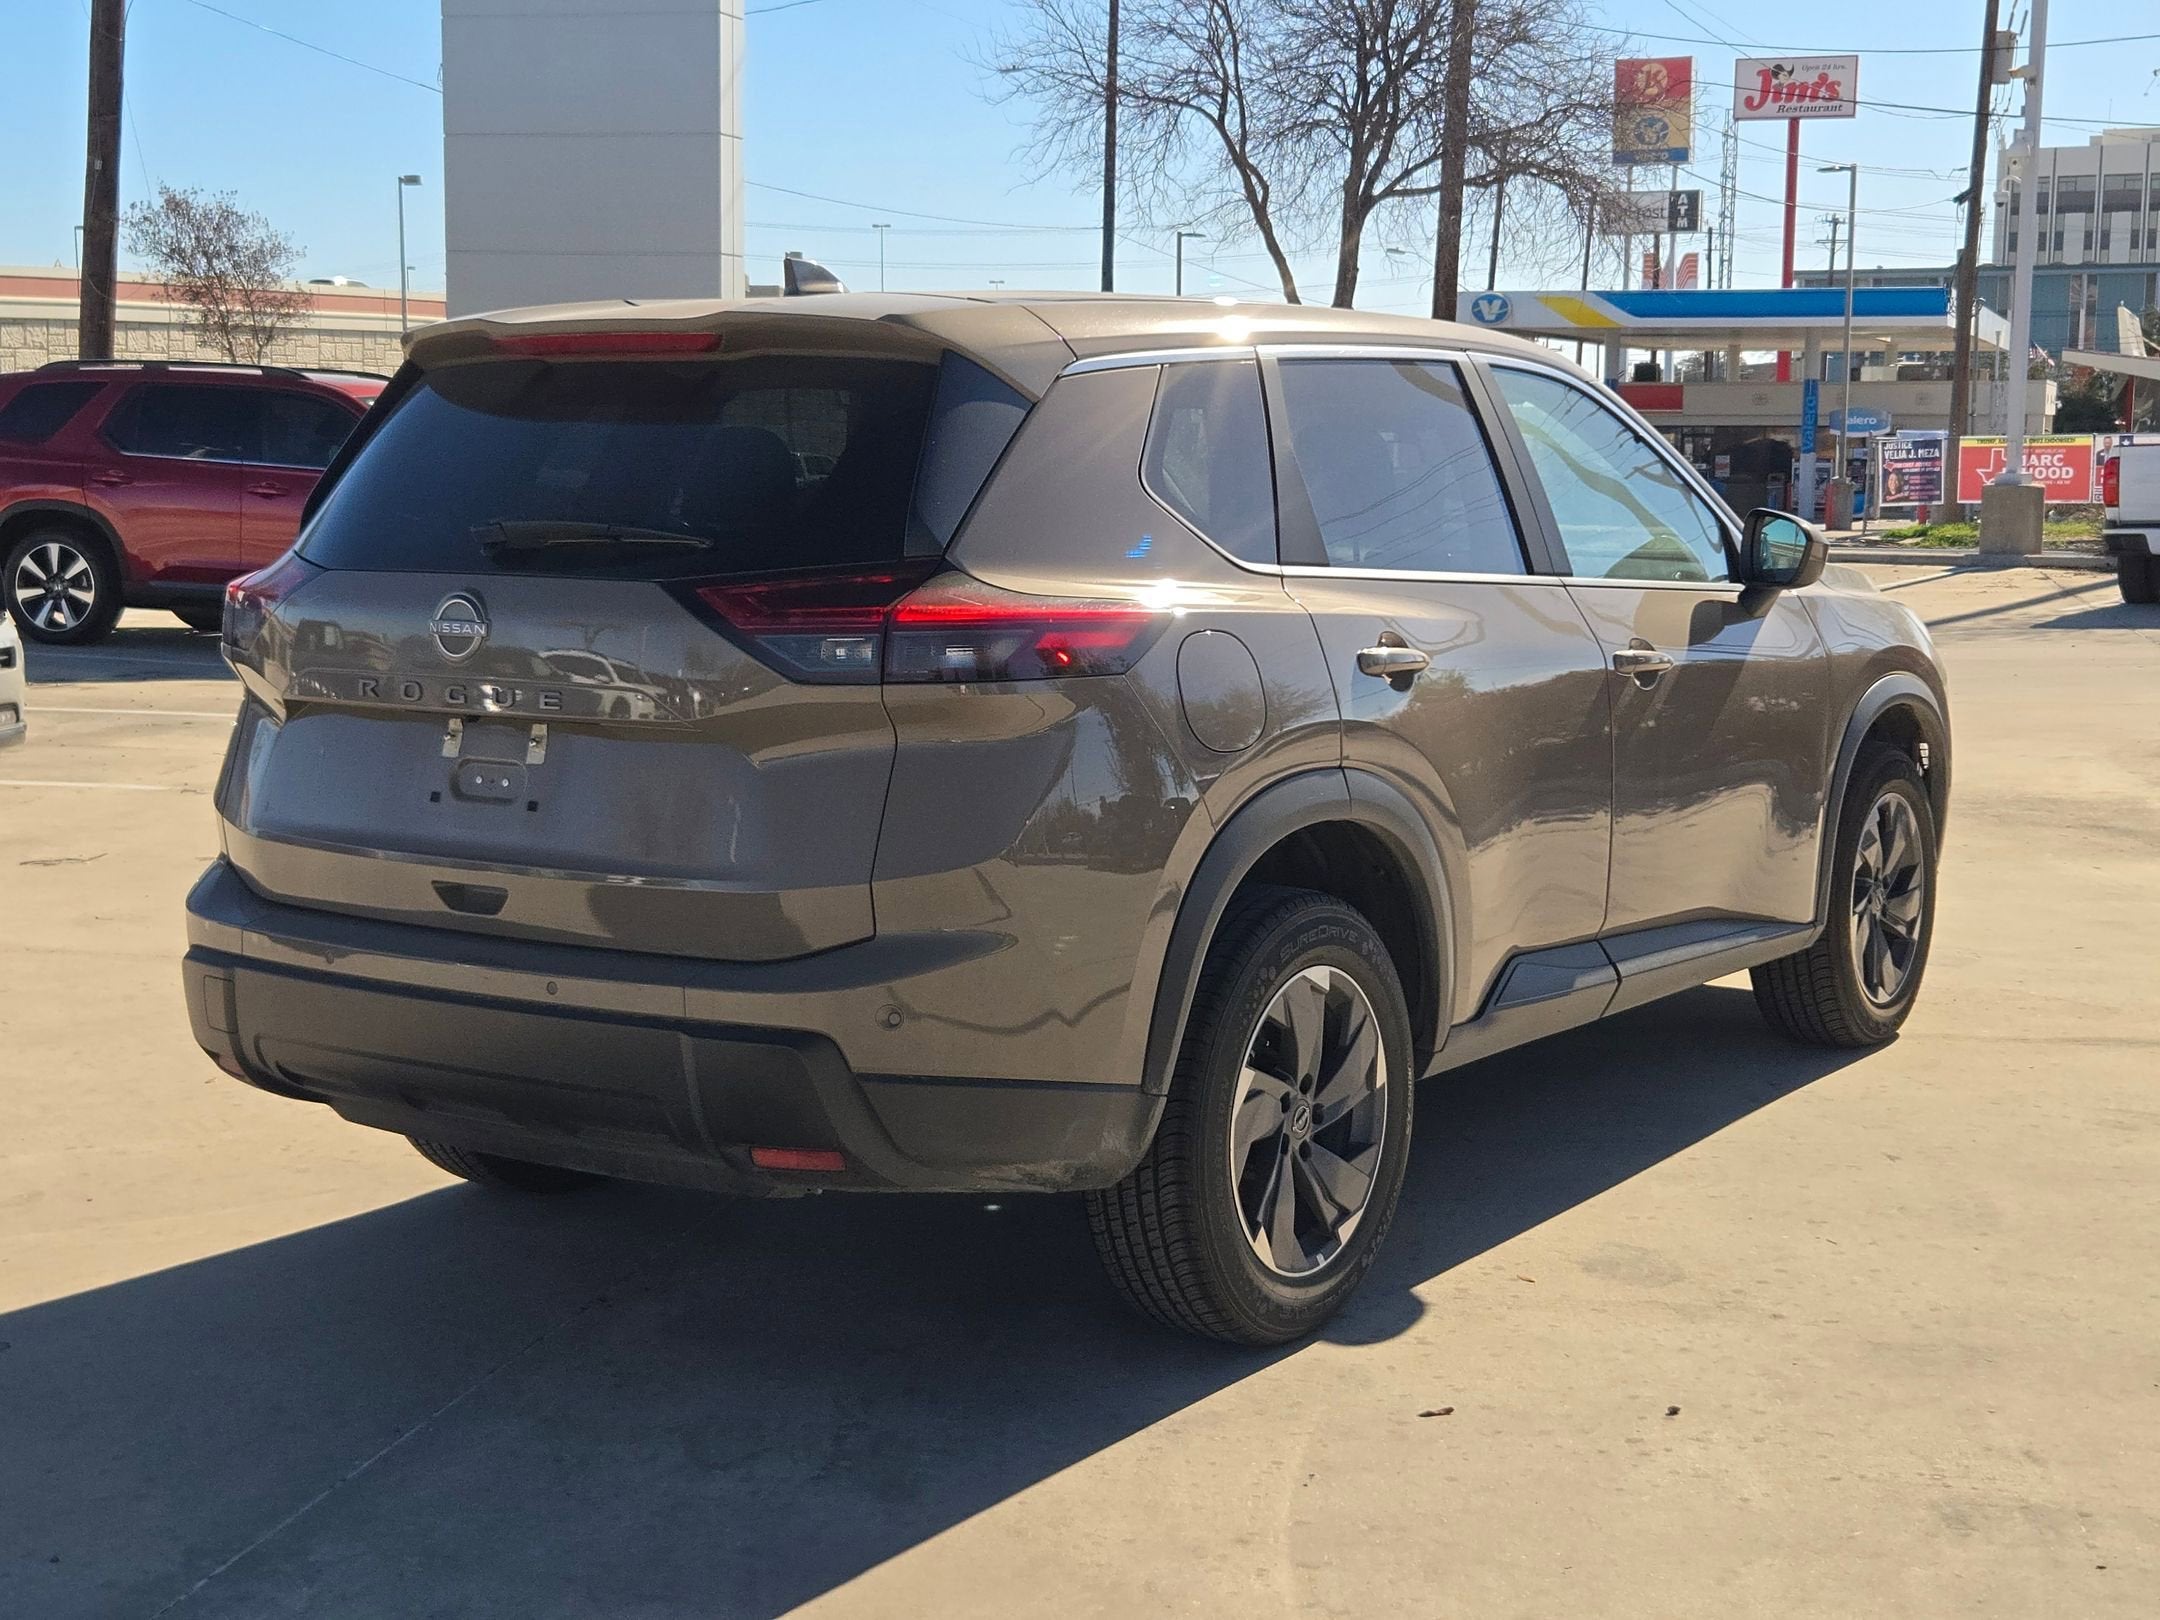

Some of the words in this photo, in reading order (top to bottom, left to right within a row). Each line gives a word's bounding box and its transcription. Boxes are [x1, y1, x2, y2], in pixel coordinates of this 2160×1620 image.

[1744, 68, 1842, 112] Jim's
[1776, 104, 1843, 114] Restaurant
[1677, 193, 1689, 228] ATM
[1847, 415, 1877, 425] alero
[1883, 441, 1913, 450] JUSTICE
[1884, 449, 1907, 460] VELIA
[1908, 449, 1917, 459] J.
[1917, 448, 1940, 459] MEZA
[429, 622, 486, 635] NISSAN
[358, 678, 562, 711] ROGUE
